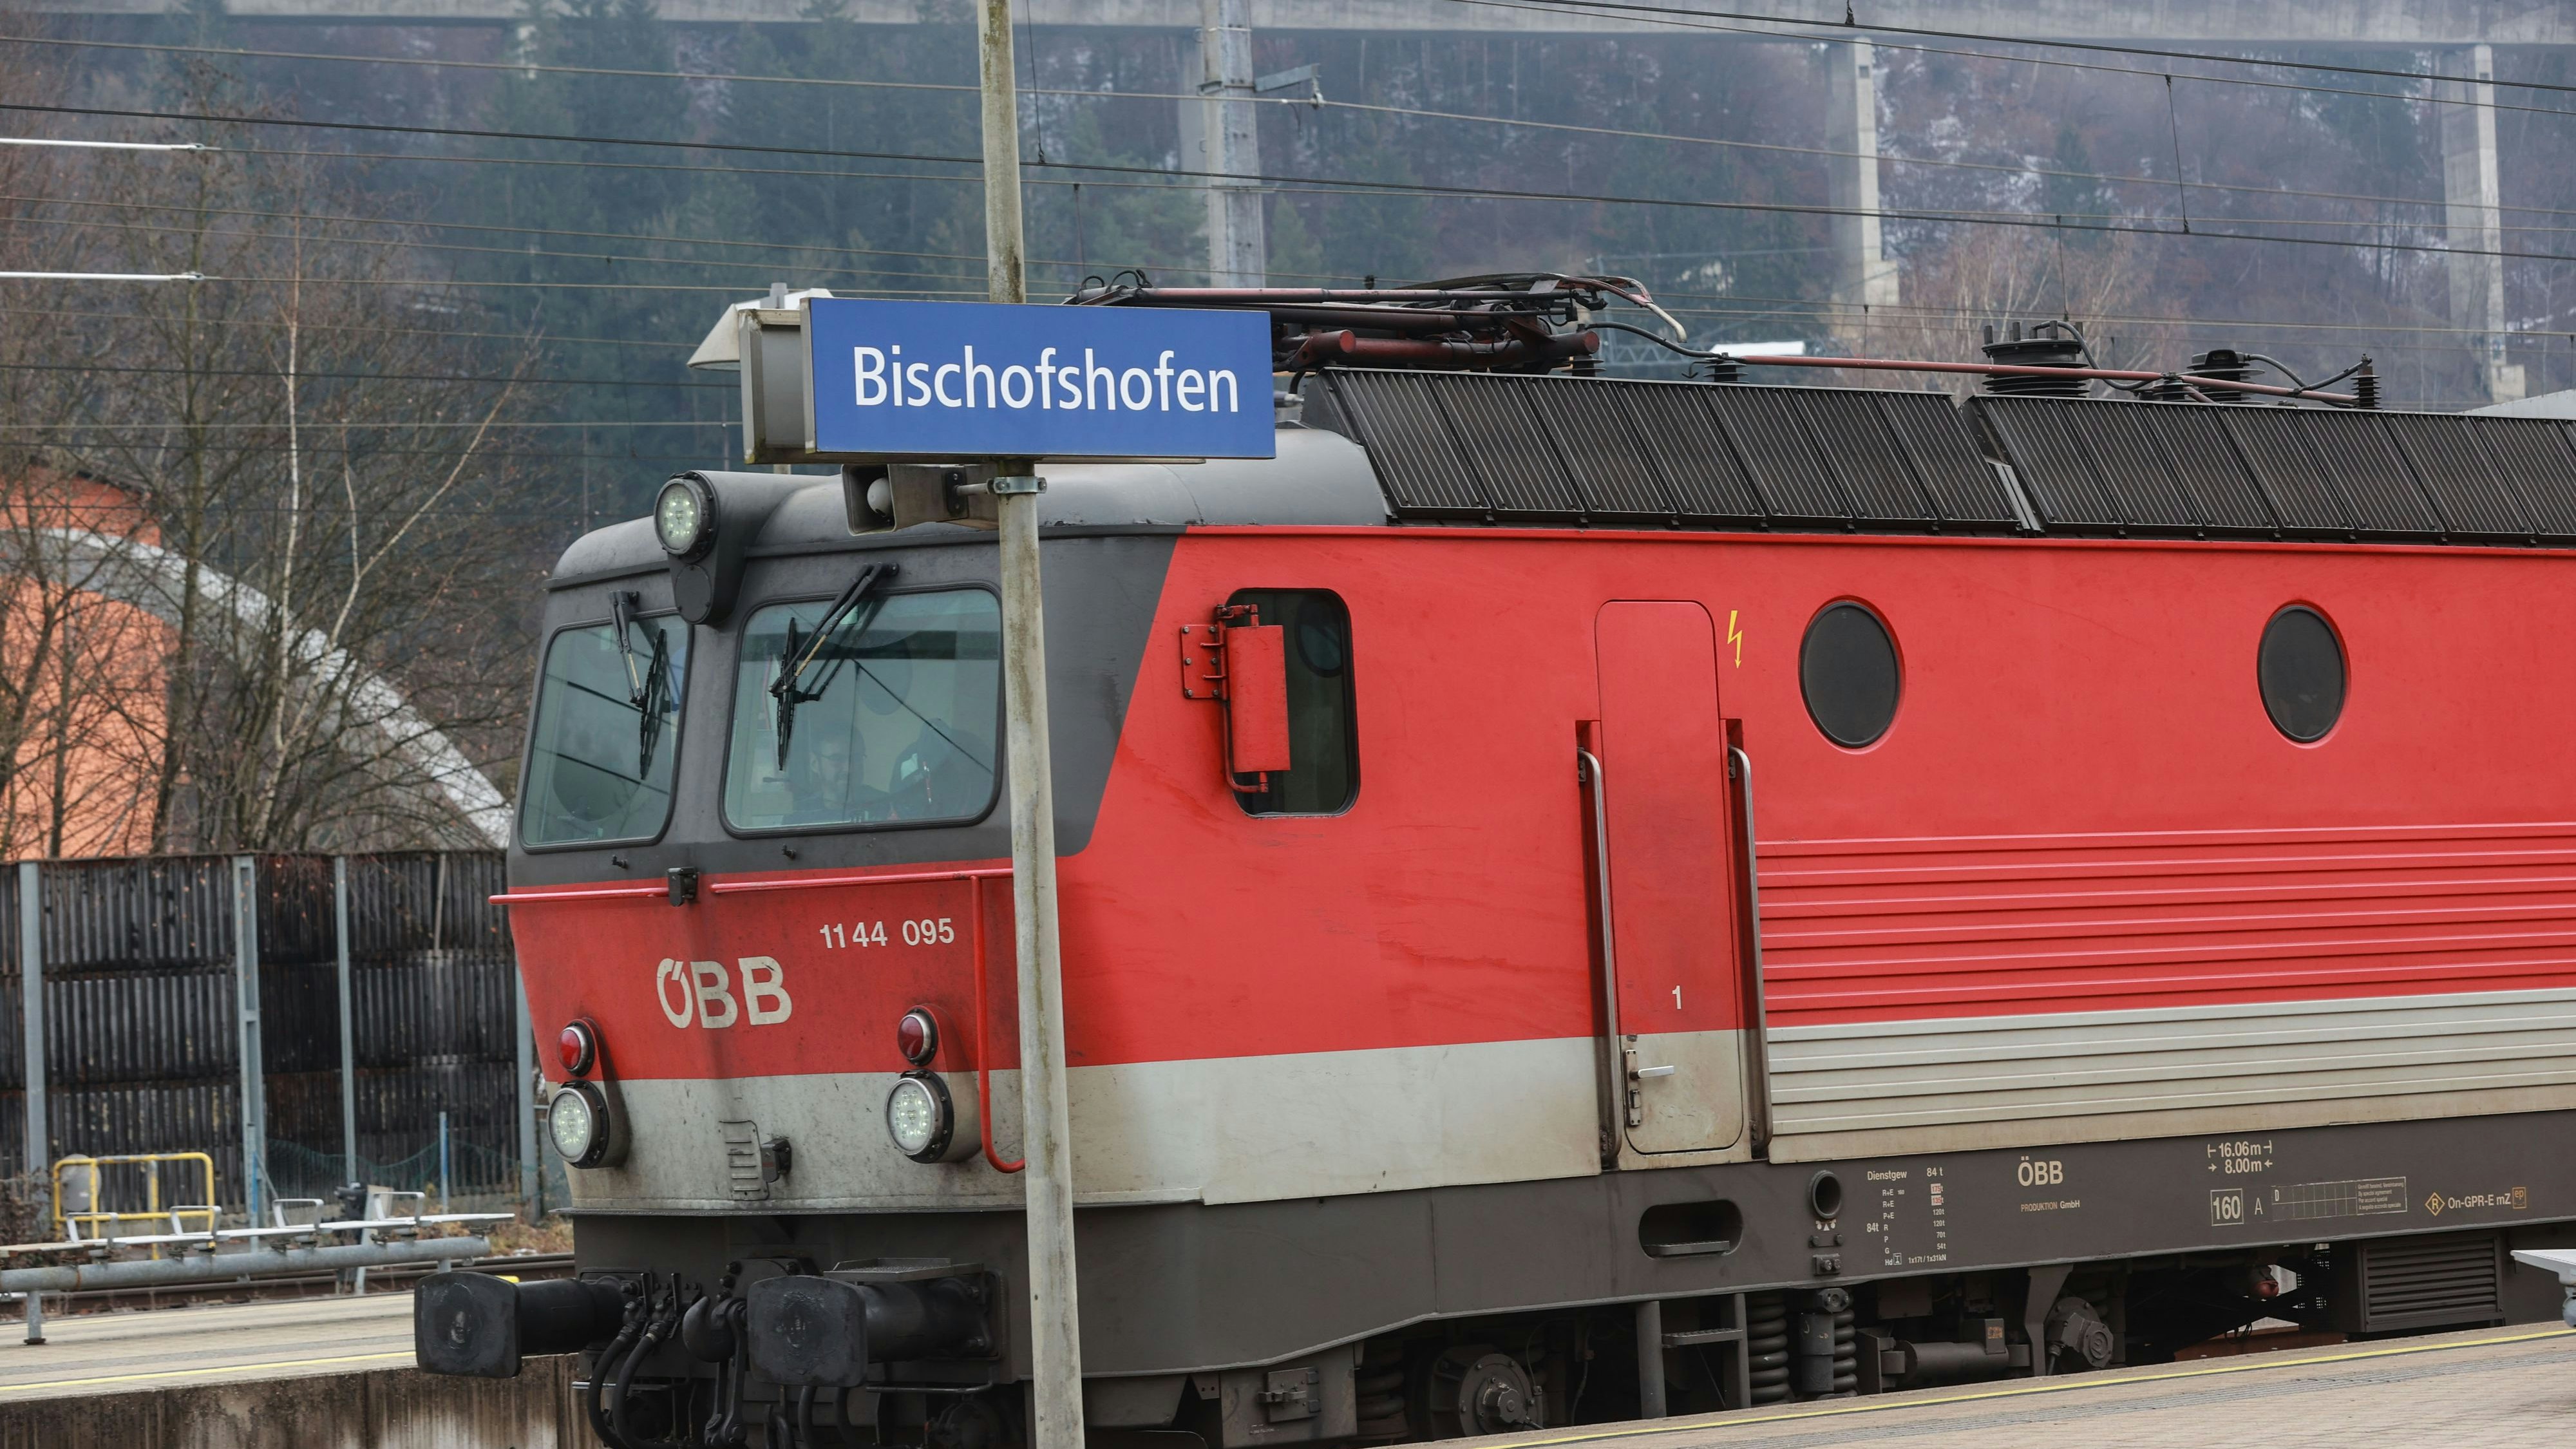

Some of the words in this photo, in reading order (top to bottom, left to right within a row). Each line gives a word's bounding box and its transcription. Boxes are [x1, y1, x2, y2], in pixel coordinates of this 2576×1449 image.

[853, 345, 1239, 413] Bischofshofen
[819, 920, 889, 949] 1144
[902, 917, 955, 947] 095
[656, 955, 793, 1029] ÖBB
[1671, 985, 1682, 1010] 1
[2218, 1141, 2262, 1158] 16.06m
[2018, 1155, 2063, 1187] ÖBB
[2224, 1157, 2262, 1174] 8.00m
[1867, 1170, 1908, 1181] Dienstgew
[1926, 1167, 1938, 1177] 84
[2275, 1189, 2280, 1202] D
[2447, 1194, 2495, 1209] On-GPR-E
[2496, 1193, 2512, 1206] mZ
[1882, 1200, 1895, 1208] R+E
[2020, 1201, 2058, 1213] PRODUKTION
[2060, 1199, 2080, 1209] GmbH
[2213, 1195, 2241, 1220] 160
[2254, 1197, 2263, 1215] A
[2431, 1198, 2439, 1210] R
[1866, 1222, 1879, 1233] 84t
[1884, 1235, 1889, 1244] P
[1885, 1258, 1893, 1266] Hd
